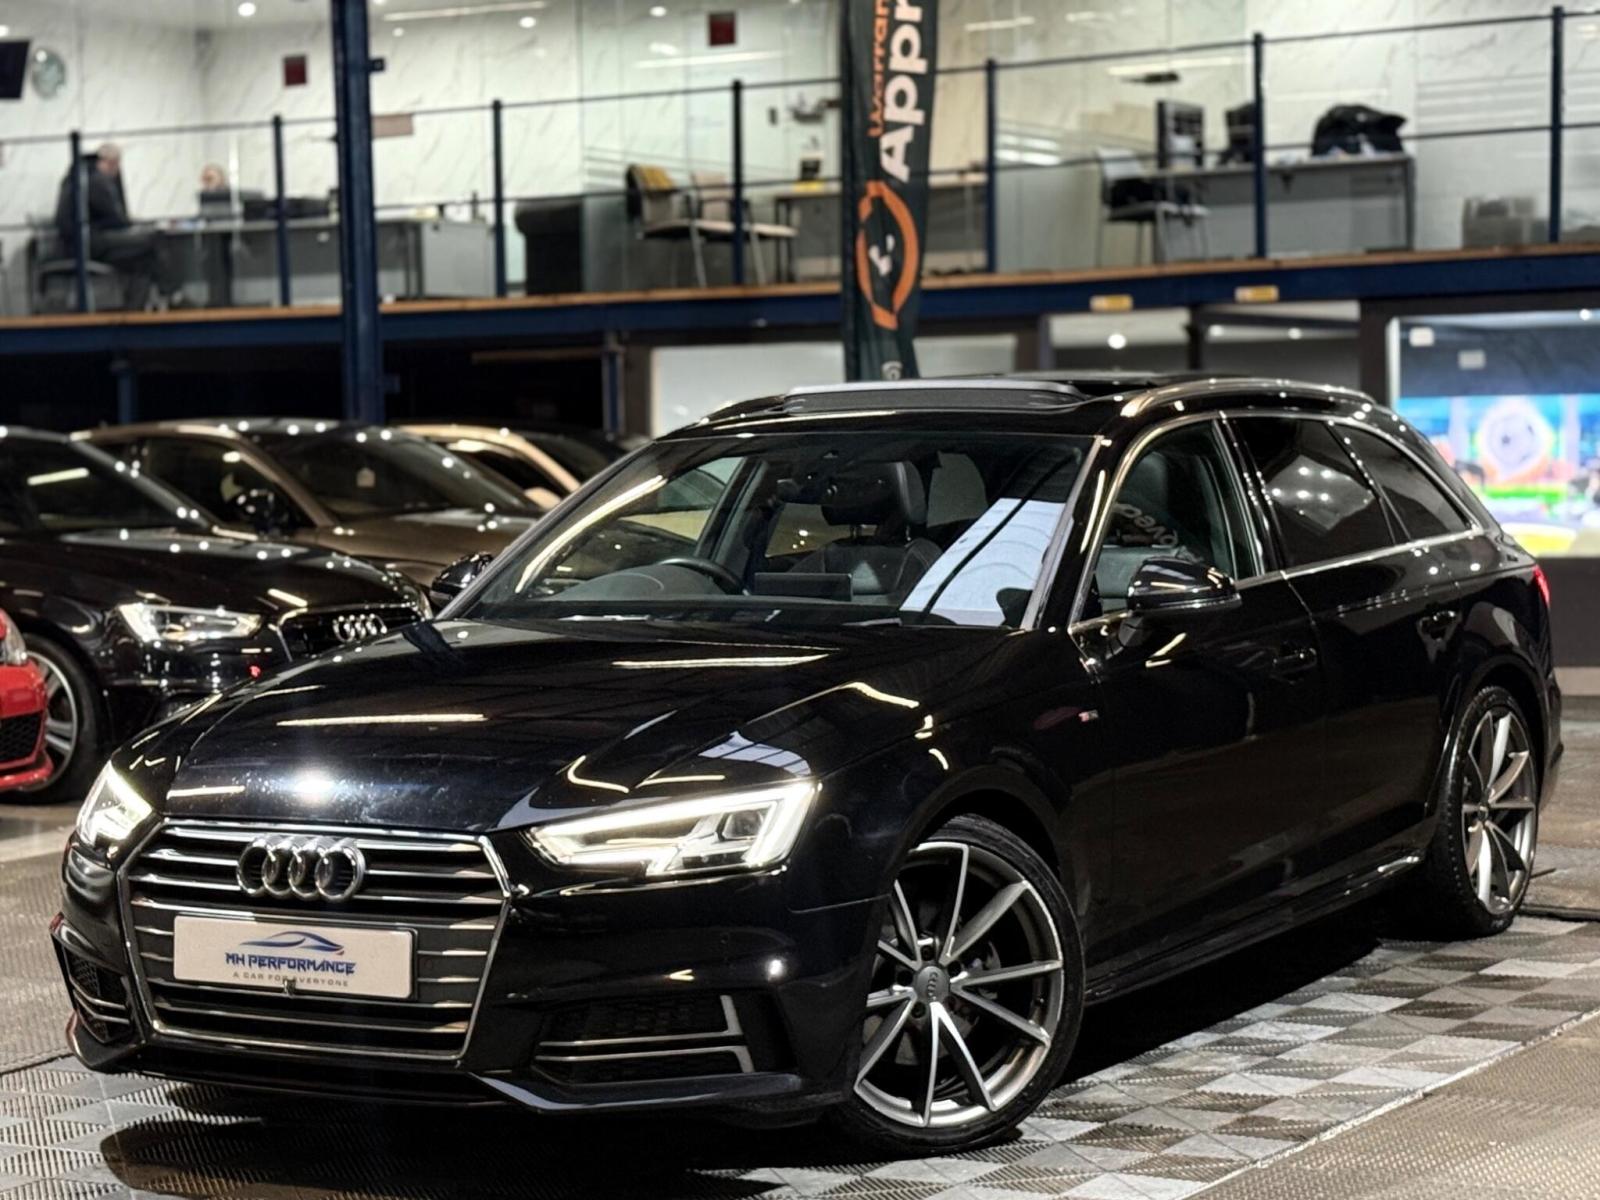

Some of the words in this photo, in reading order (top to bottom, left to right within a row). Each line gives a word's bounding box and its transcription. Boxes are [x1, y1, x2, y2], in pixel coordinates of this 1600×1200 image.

[225, 952, 246, 967] MH
[248, 954, 356, 976] PERFORMANCE
[243, 971, 265, 980] CAR
[292, 976, 349, 987] VERYONE
